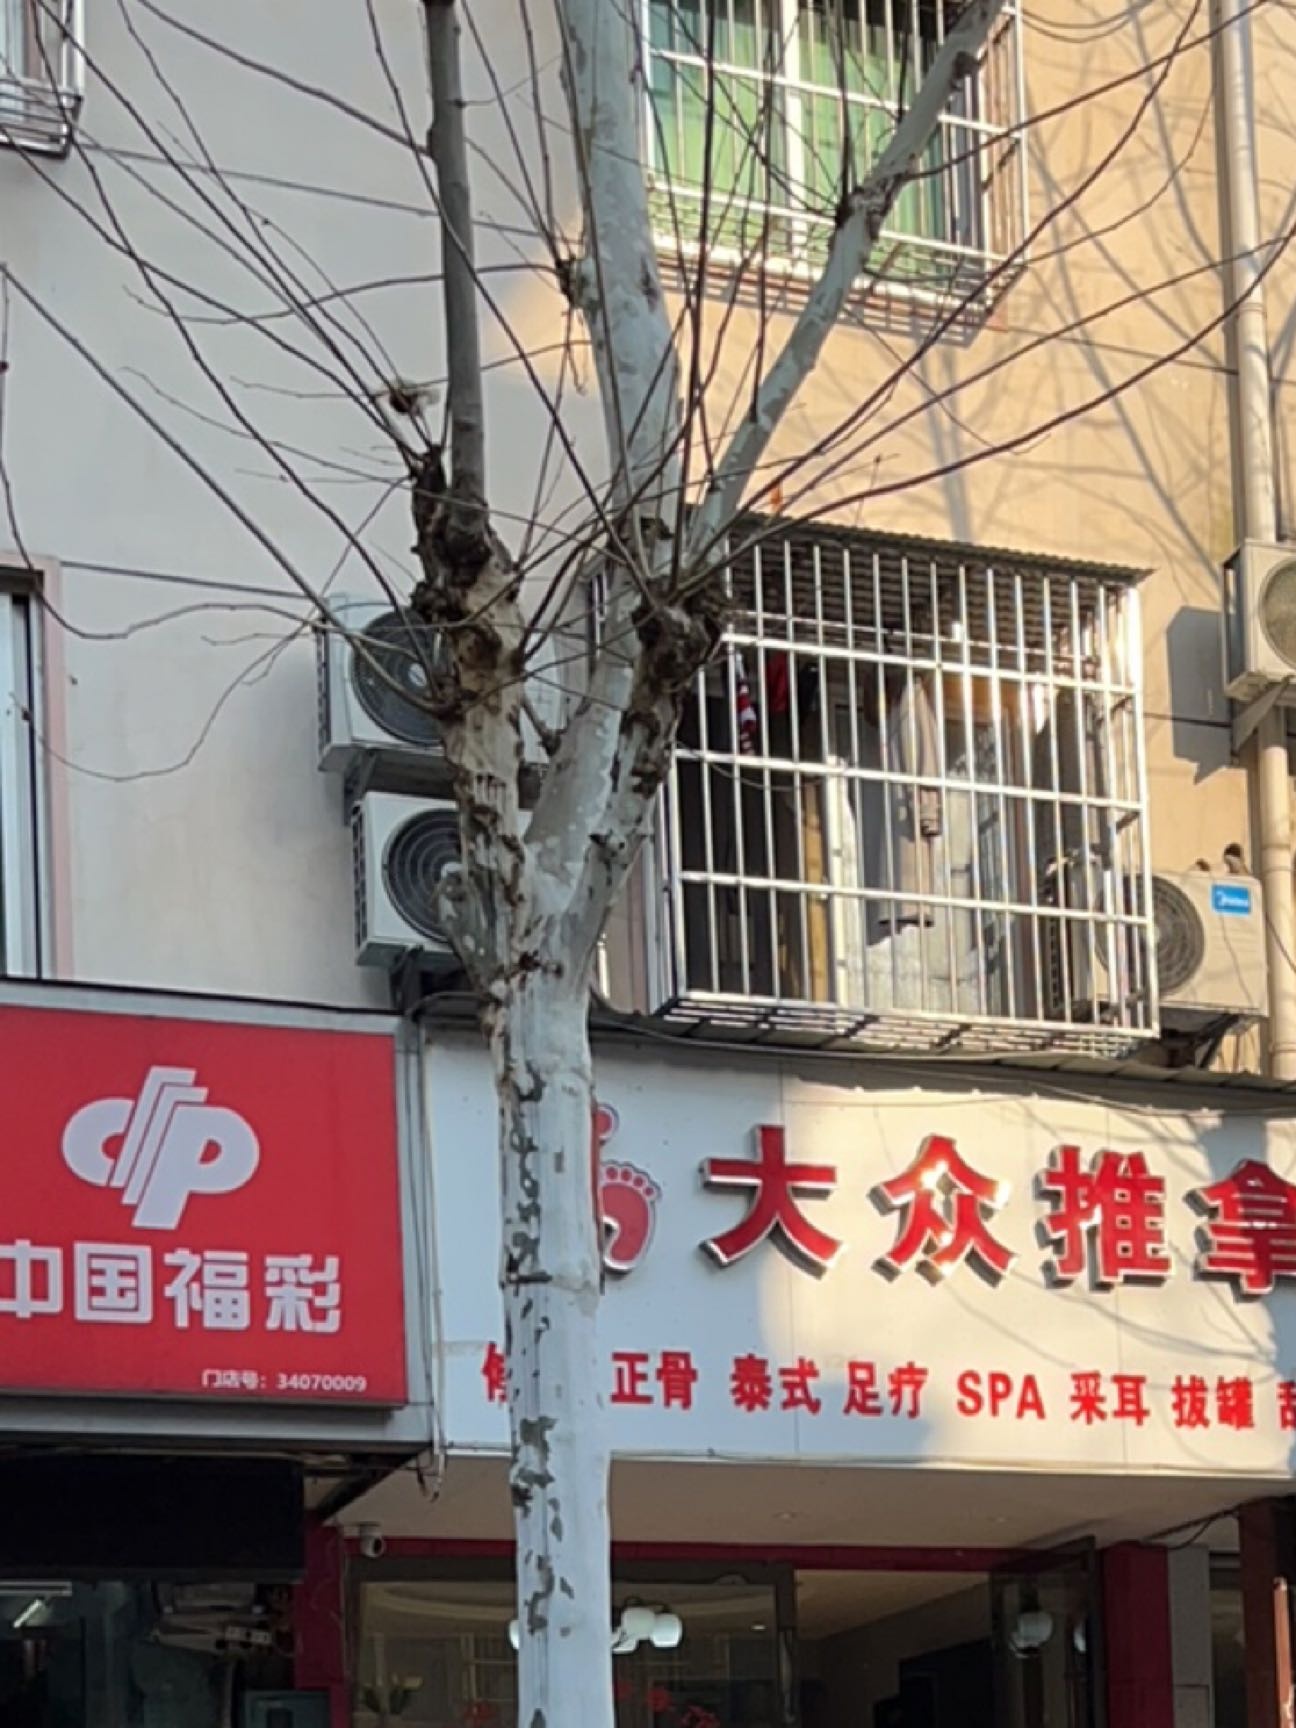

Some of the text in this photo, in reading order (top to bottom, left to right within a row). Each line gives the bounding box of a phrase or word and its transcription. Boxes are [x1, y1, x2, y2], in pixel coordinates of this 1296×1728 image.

[0, 1238, 340, 1333] 中国福彩
[610, 1350, 699, 1411] 正骨
[729, 1353, 822, 1417] 泰式
[842, 1360, 929, 1419] 足疗
[956, 1369, 1047, 1420] SPA
[1069, 1370, 1150, 1426] 采耳
[1170, 1374, 1255, 1431] 拔罐
